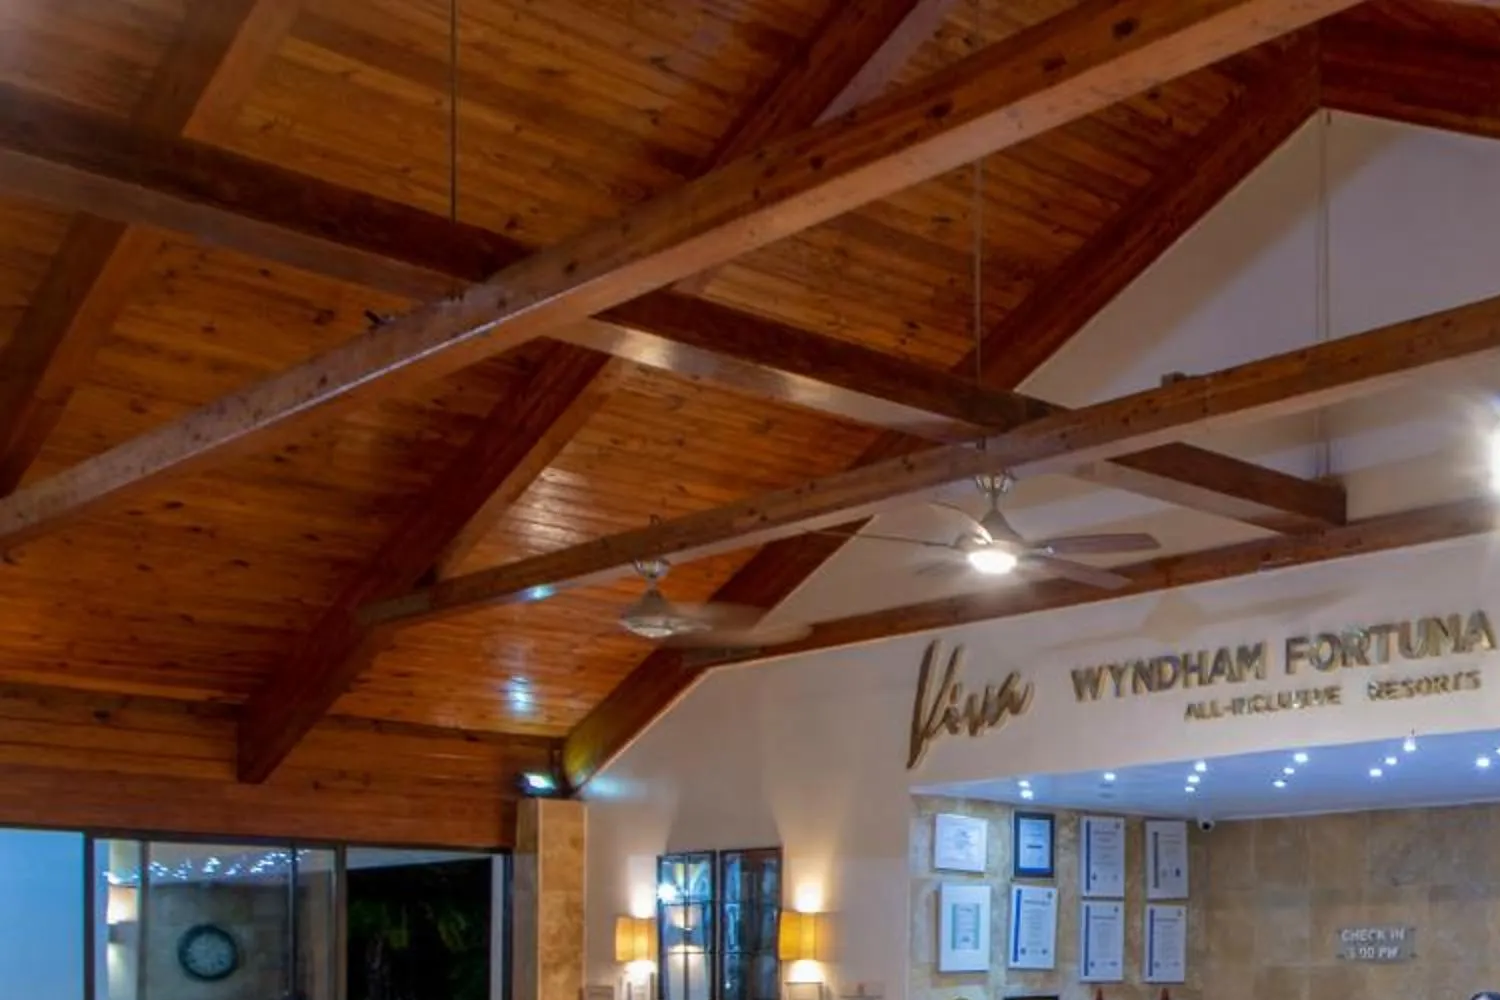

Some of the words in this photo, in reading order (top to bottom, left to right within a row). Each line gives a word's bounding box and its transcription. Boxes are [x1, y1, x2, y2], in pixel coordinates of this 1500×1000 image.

[1071, 640, 1267, 702] WYNDHAM
[1284, 609, 1497, 675] FORTUNA
[1367, 669, 1482, 700] RESORTS
[906, 638, 1034, 770] Viva
[1341, 928, 1384, 941] CHECK
